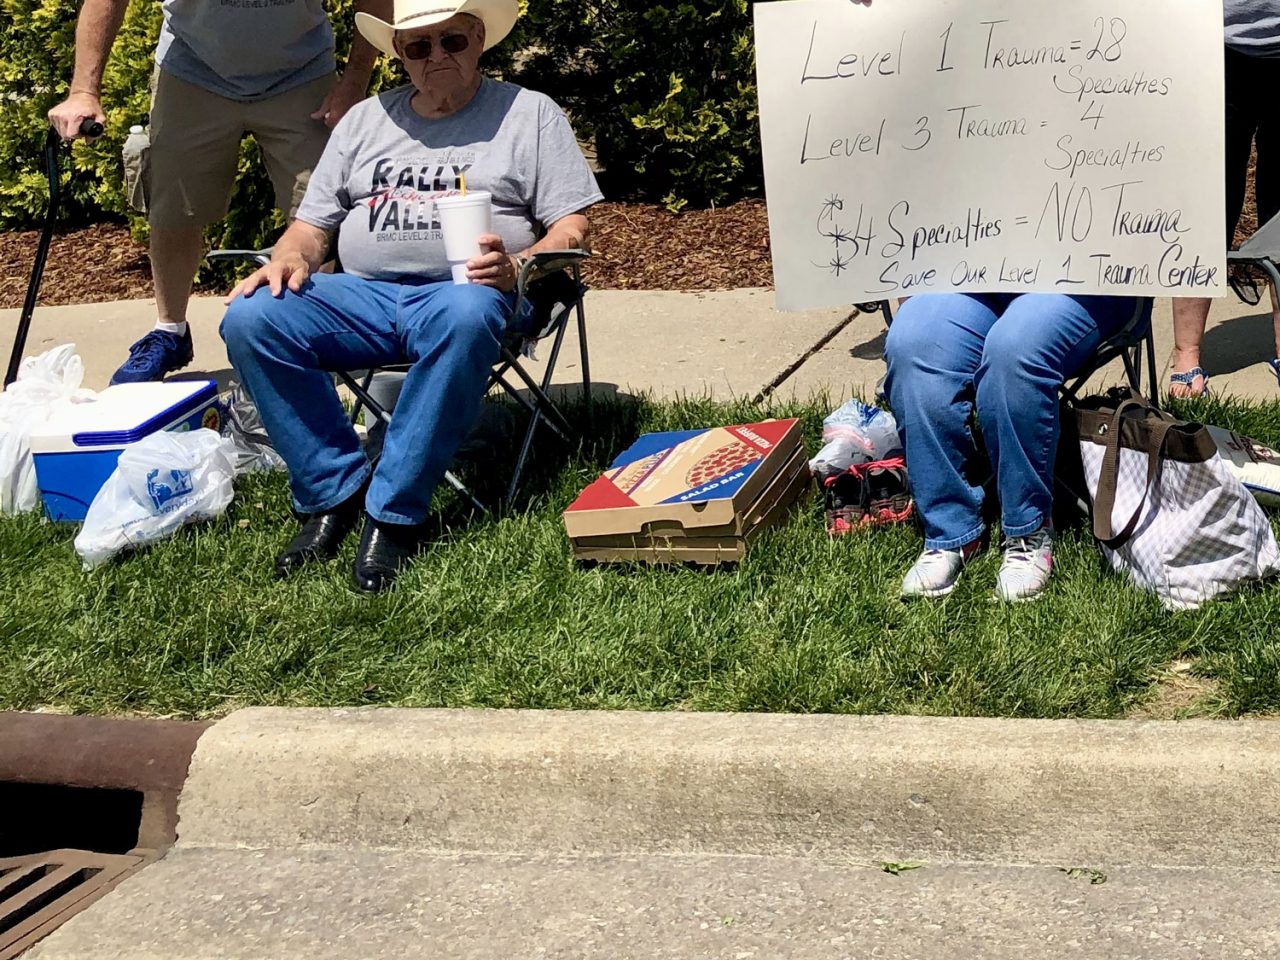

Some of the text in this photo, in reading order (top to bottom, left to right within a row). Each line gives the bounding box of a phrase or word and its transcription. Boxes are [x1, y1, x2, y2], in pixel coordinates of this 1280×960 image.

[801, 20, 905, 84] Level
[936, 22, 953, 72] 1
[1053, 64, 1173, 103] Specialties
[801, 113, 886, 165] Level
[901, 115, 931, 151] 3
[1080, 100, 1105, 130] 4
[371, 157, 472, 192] RALLY
[1044, 135, 1166, 178] Specialties
[368, 193, 441, 232] VALLE
[881, 200, 1002, 262] Specialties
[1035, 181, 1093, 243] NO
[399, 231, 422, 241] LEVEL
[424, 231, 429, 241] 2
[865, 261, 937, 293] Save
[999, 259, 1037, 286] Level
[1056, 256, 1085, 286] 1
[1158, 243, 1219, 289] Center
[680, 482, 719, 501] SALAD
[720, 471, 744, 485] BAR
